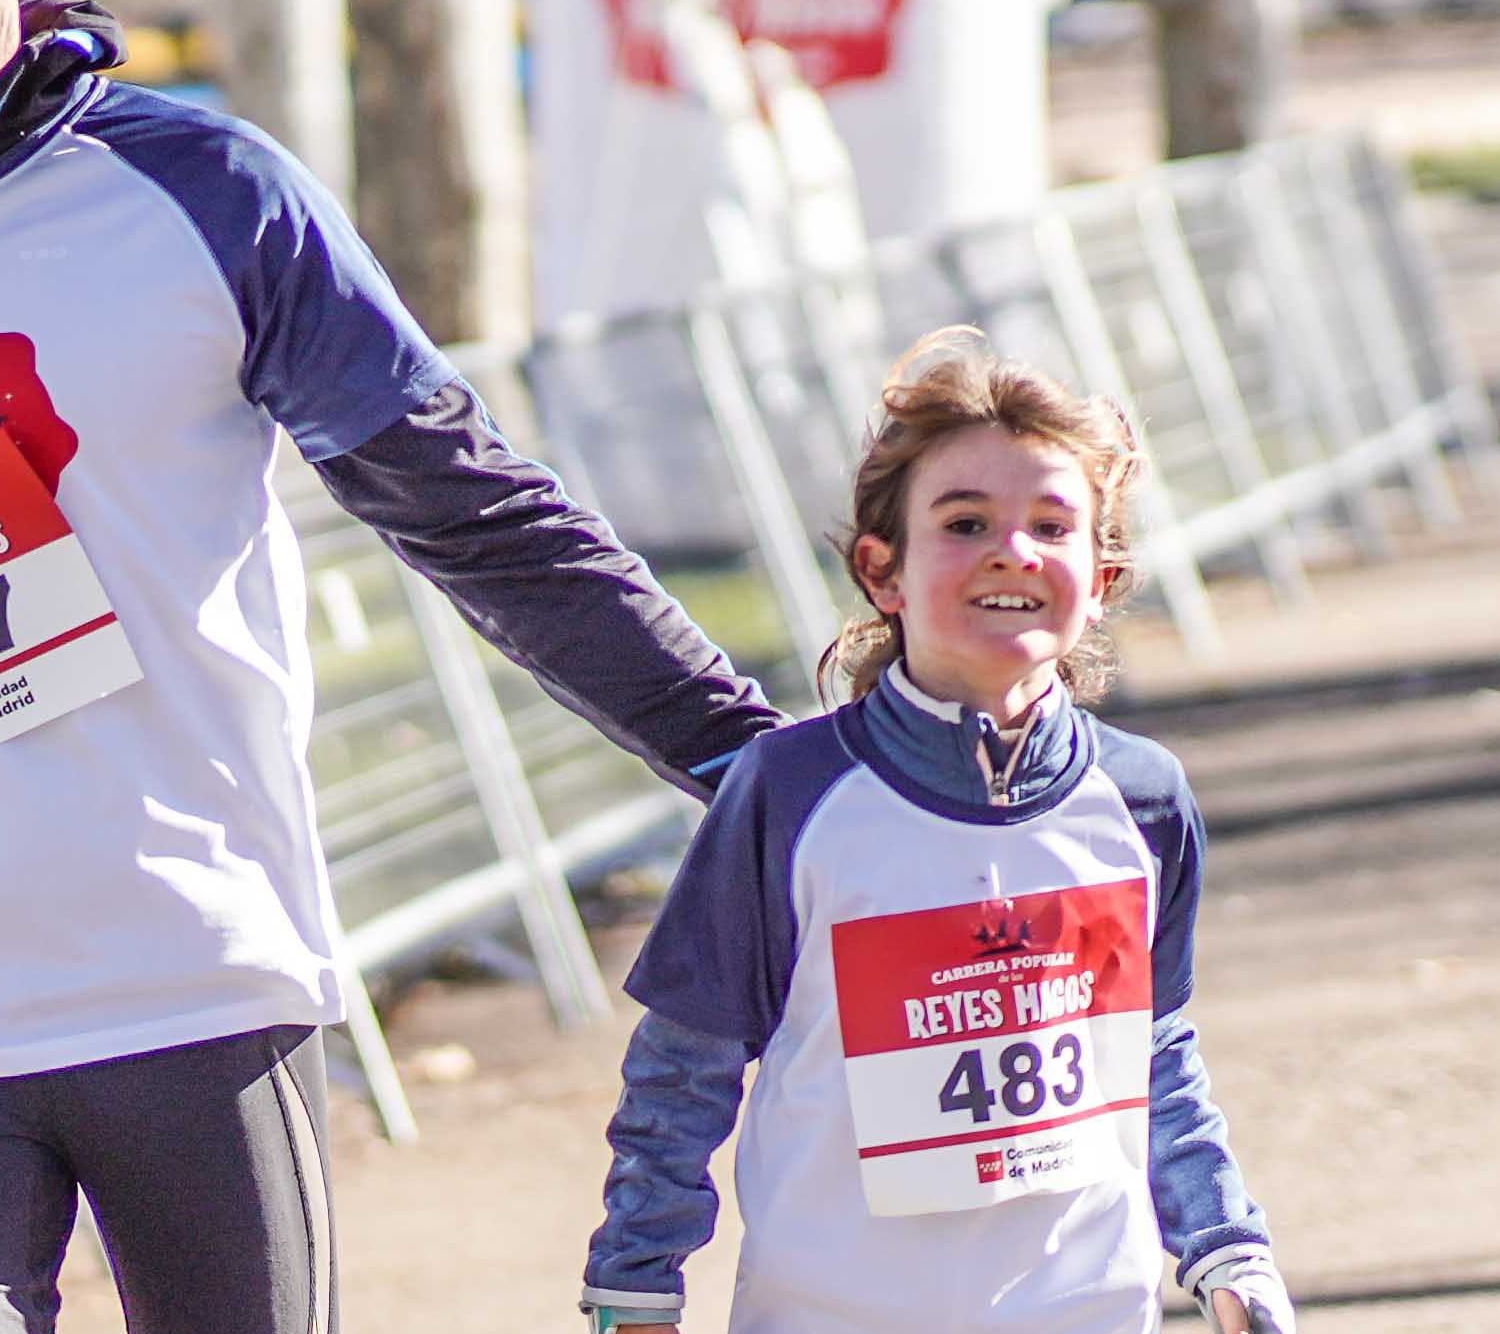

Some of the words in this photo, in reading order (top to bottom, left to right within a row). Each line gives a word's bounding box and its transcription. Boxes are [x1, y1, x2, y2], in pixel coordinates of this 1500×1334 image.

[931, 959, 1008, 985] CARRERA
[1011, 951, 1075, 970] POPULAR
[904, 988, 1004, 1040] REYES
[1013, 971, 1095, 1026] MAGOS
[939, 1033, 1085, 1124] 483
[1008, 1166, 1025, 1178] de
